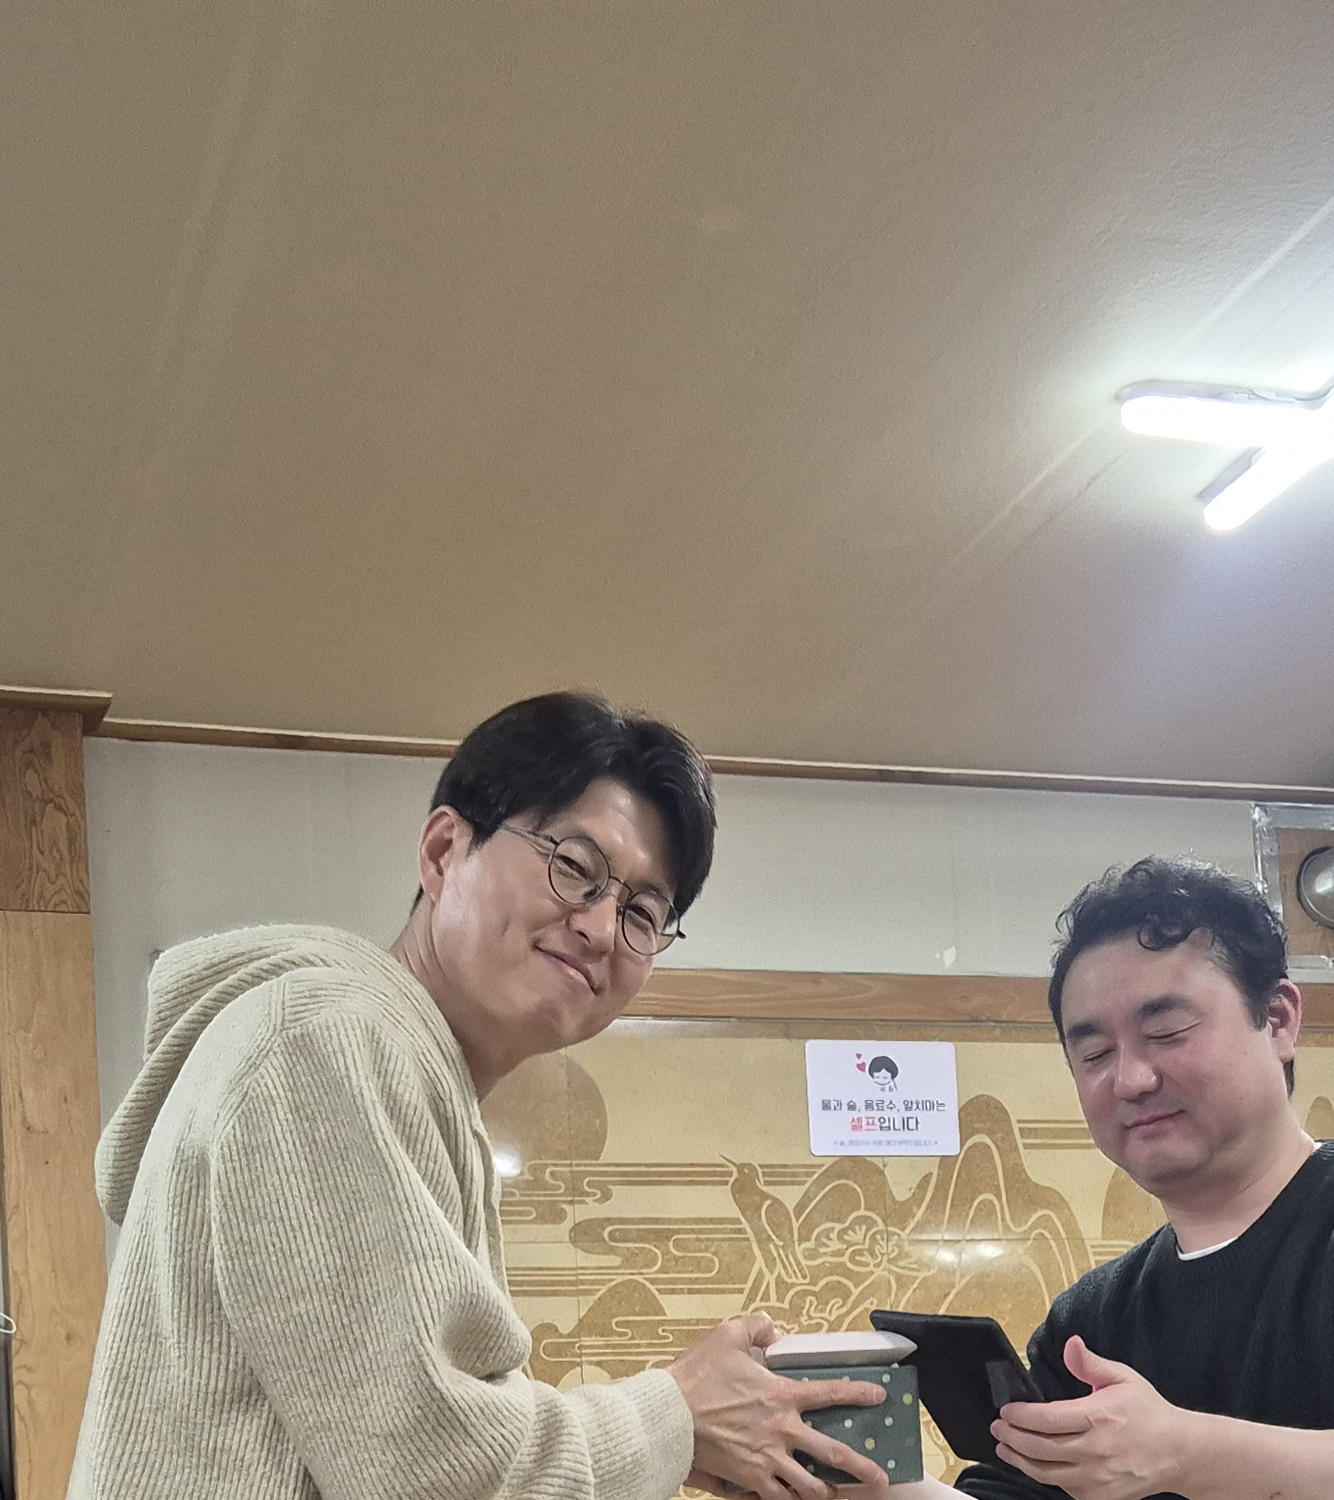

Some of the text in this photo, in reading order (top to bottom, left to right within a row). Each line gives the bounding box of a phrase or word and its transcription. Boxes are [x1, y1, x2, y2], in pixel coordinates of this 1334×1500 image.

[821, 1099, 843, 1112] 물과
[864, 1099, 901, 1113] 음료수,
[903, 1099, 947, 1112] 앞치마는
[850, 1116, 921, 1132] 셀프입니다
